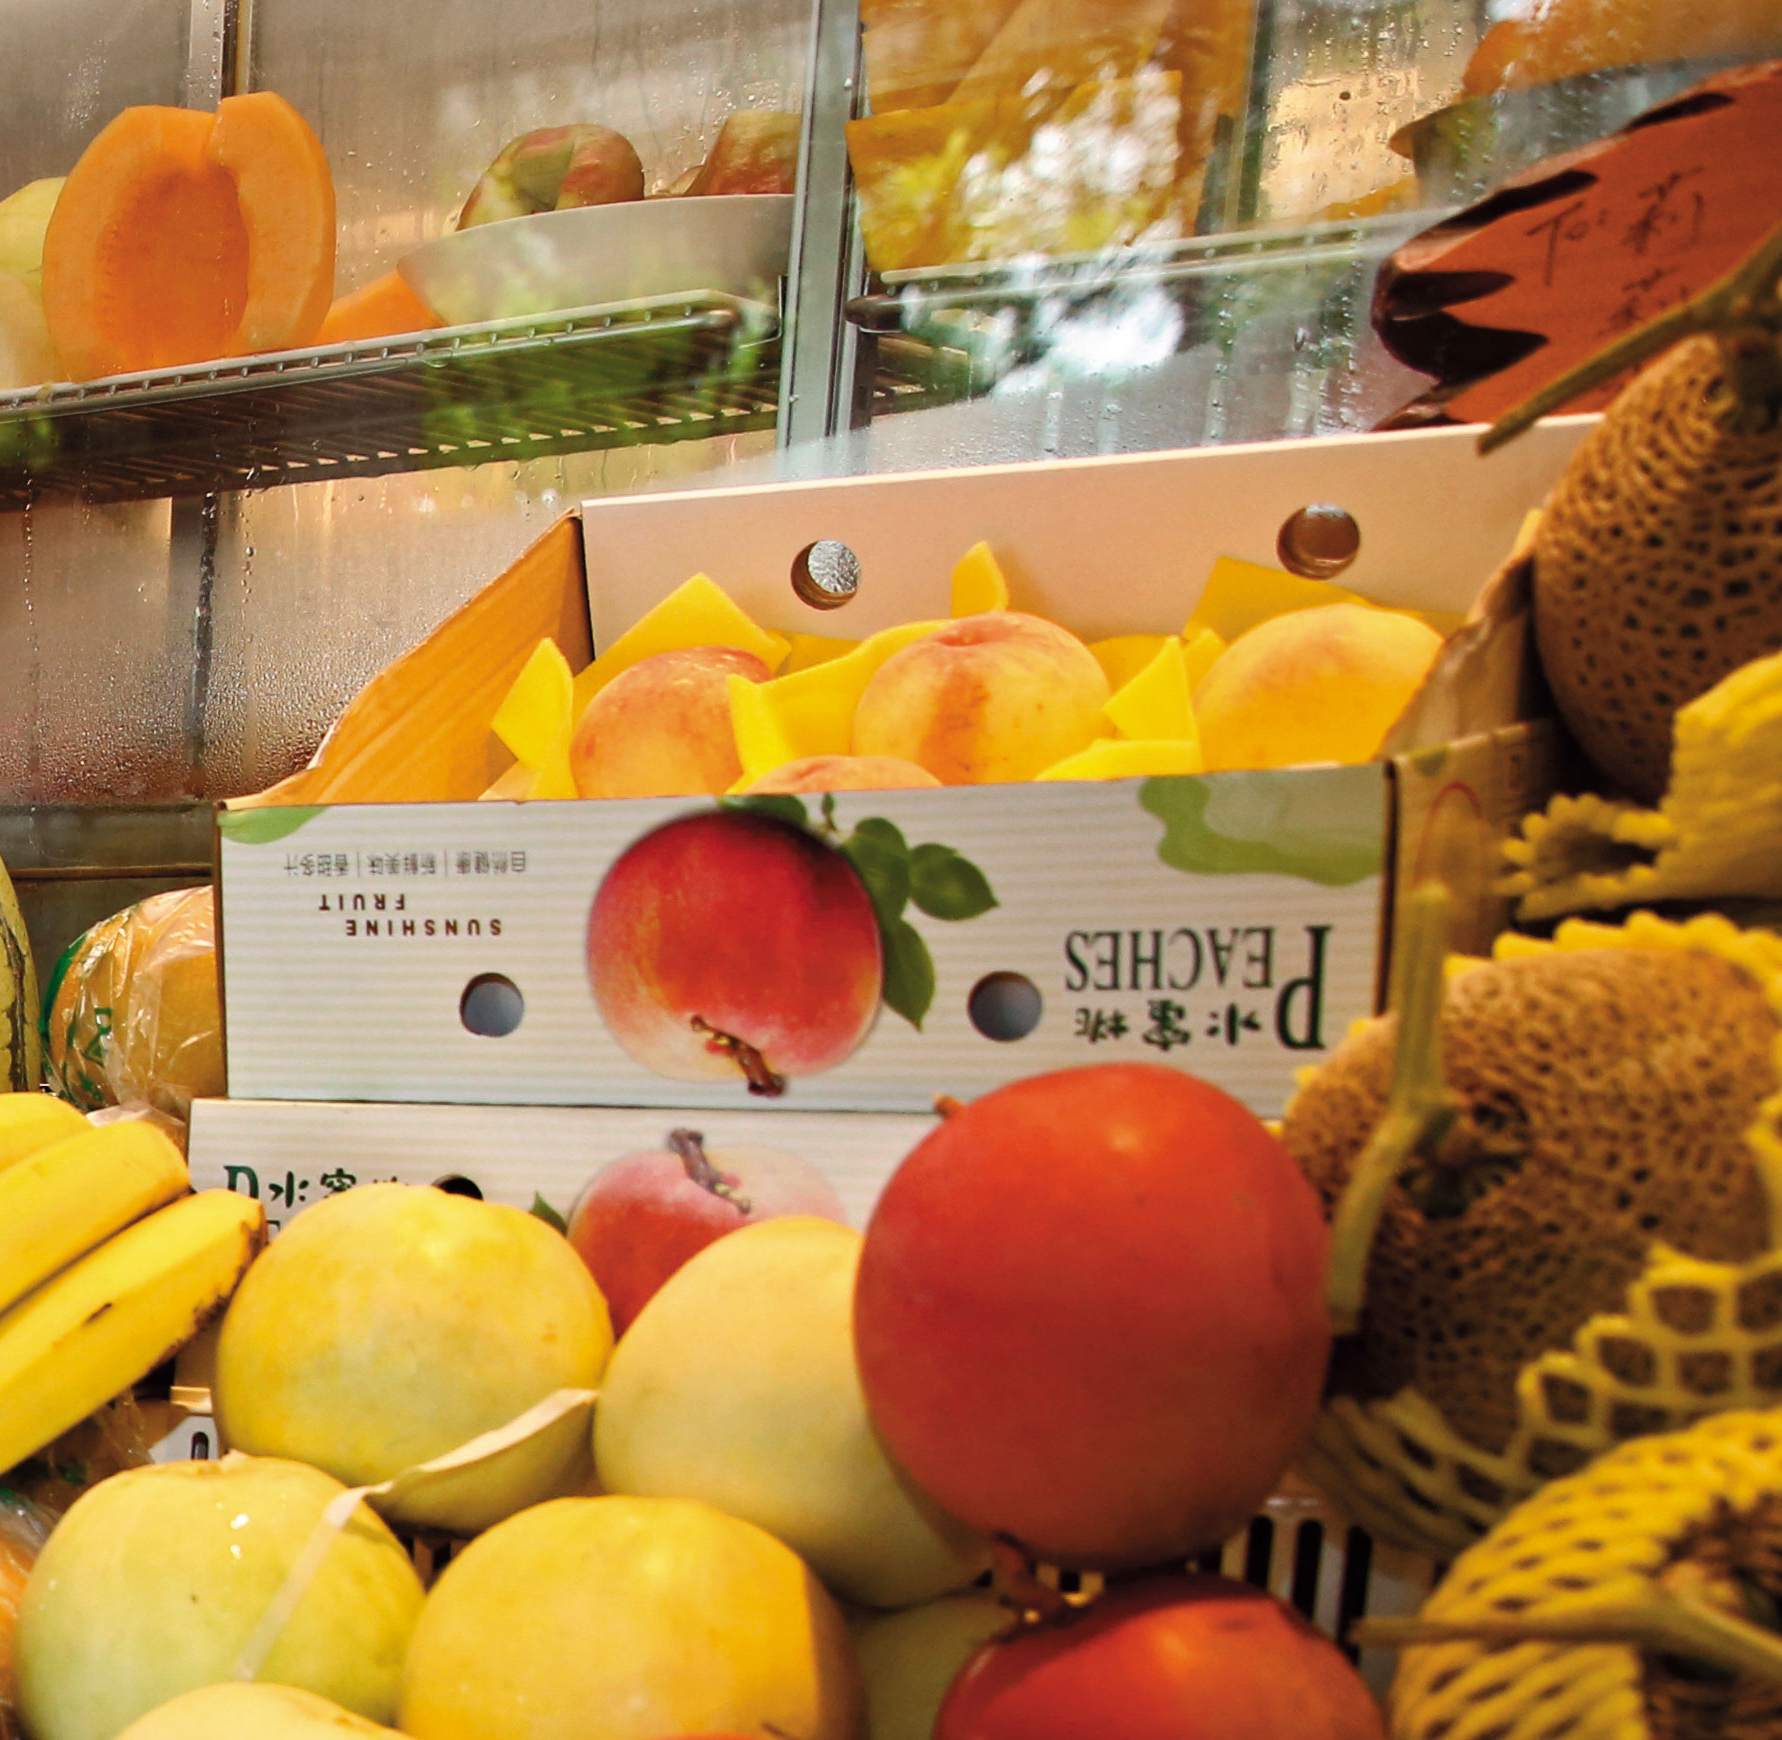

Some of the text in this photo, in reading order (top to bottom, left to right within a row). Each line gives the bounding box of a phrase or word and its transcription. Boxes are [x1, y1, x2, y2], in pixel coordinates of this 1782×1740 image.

[284, 853, 349, 878] 香甜多汁
[367, 852, 436, 877] 新鮮美味
[317, 893, 407, 911] FRUIT
[344, 918, 503, 937] SUNSHINE
[1063, 923, 1334, 1051] PEACHES
[1073, 998, 1263, 1052] 水蜜桃
